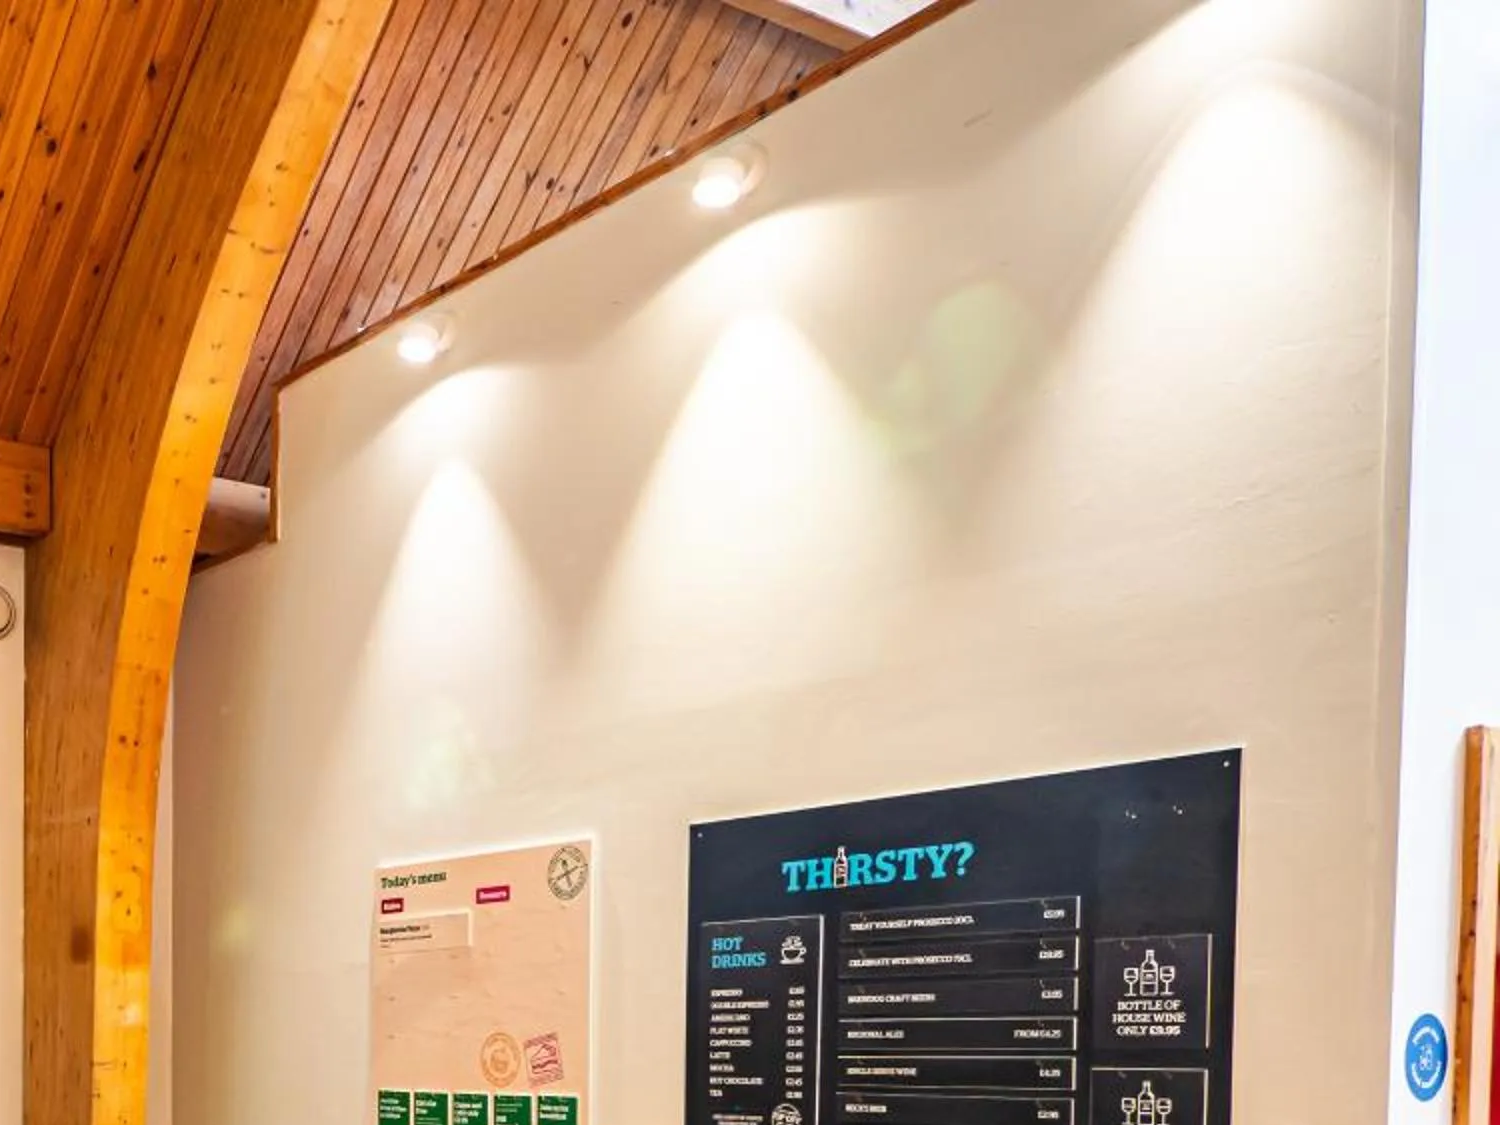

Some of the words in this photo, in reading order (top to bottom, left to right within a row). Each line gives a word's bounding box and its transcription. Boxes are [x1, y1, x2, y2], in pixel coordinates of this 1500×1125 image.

[381, 873, 416, 889] Today's
[418, 871, 447, 884] menu
[711, 936, 744, 951] HOT
[711, 952, 767, 969] DRINKS
[1117, 1000, 1162, 1011] BOTTLE
[1164, 1000, 1182, 1010] OF
[1112, 1013, 1152, 1023] HOUSE
[1153, 1012, 1187, 1023] WINE
[1116, 1025, 1148, 1036] ONLY
